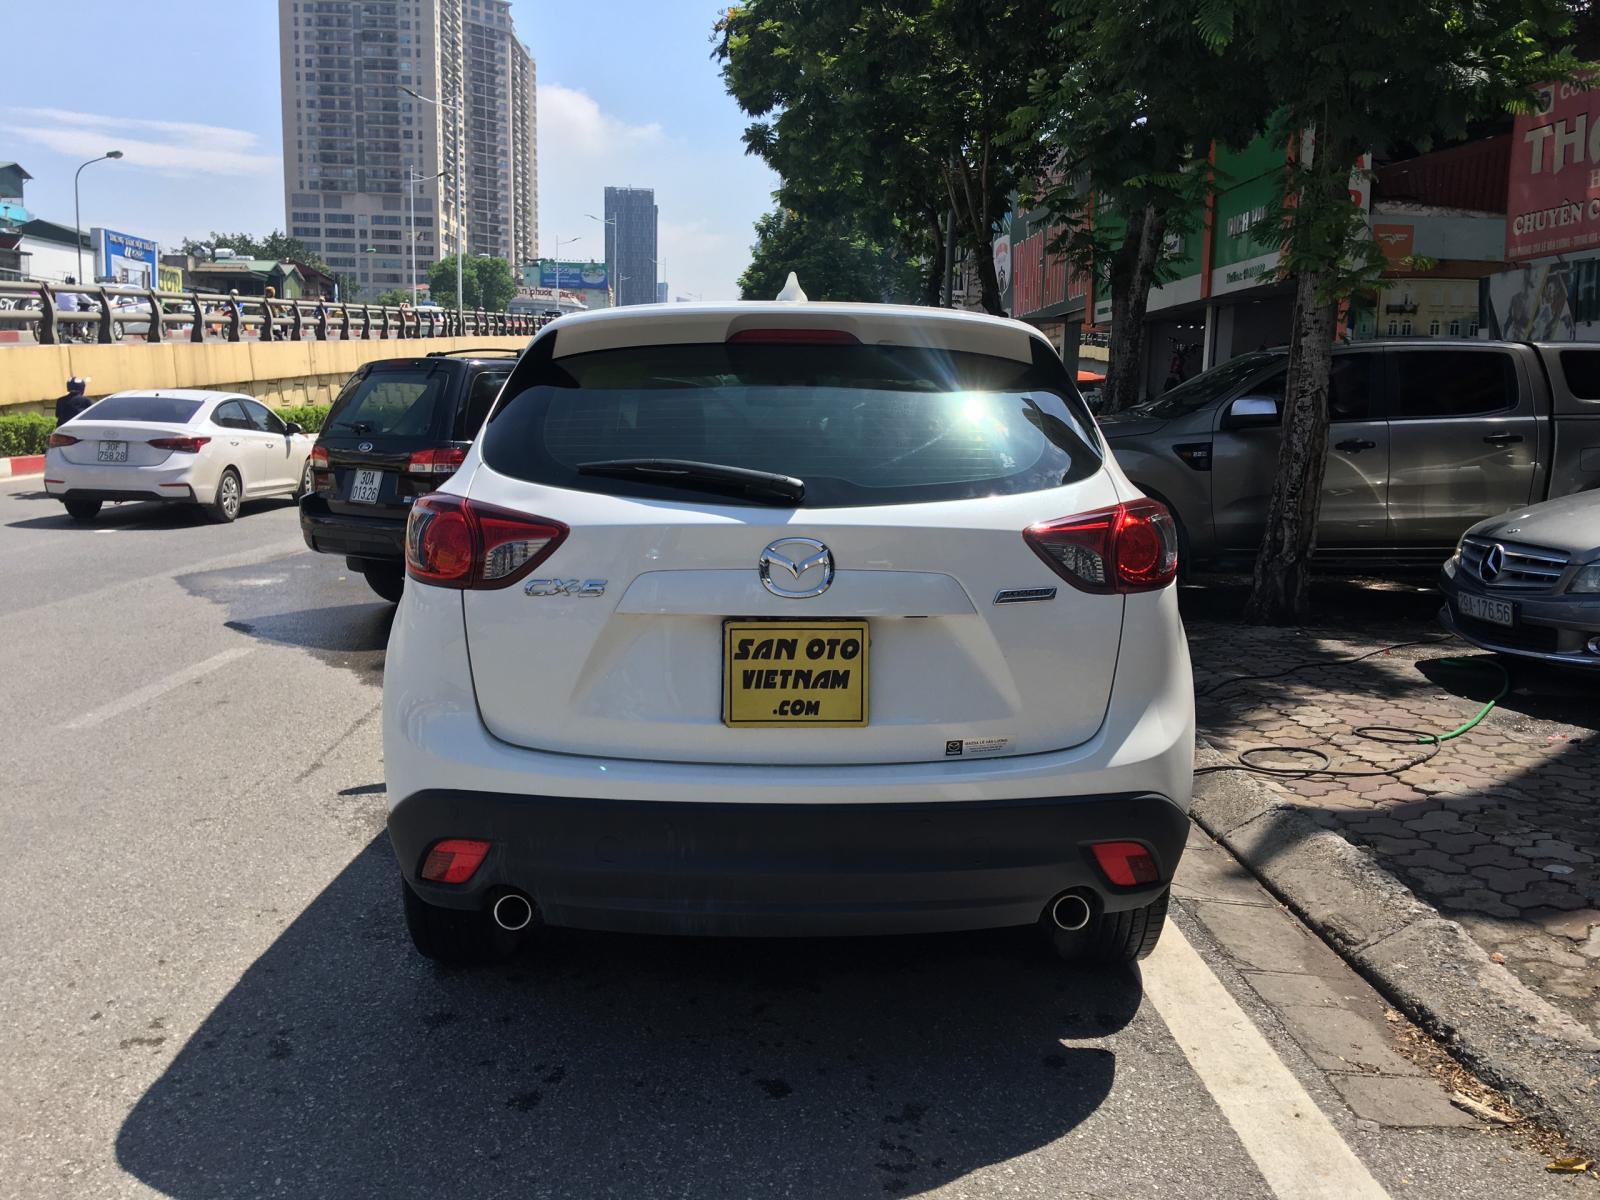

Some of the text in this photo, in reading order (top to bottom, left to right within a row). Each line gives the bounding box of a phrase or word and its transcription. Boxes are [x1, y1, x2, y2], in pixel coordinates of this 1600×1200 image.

[1513, 199, 1584, 236] CHUYÊN
[360, 471, 376, 485] 30A
[734, 638, 860, 660] SAN OTO
[742, 669, 850, 690] VIETNAM
[773, 699, 820, 716] .COM
